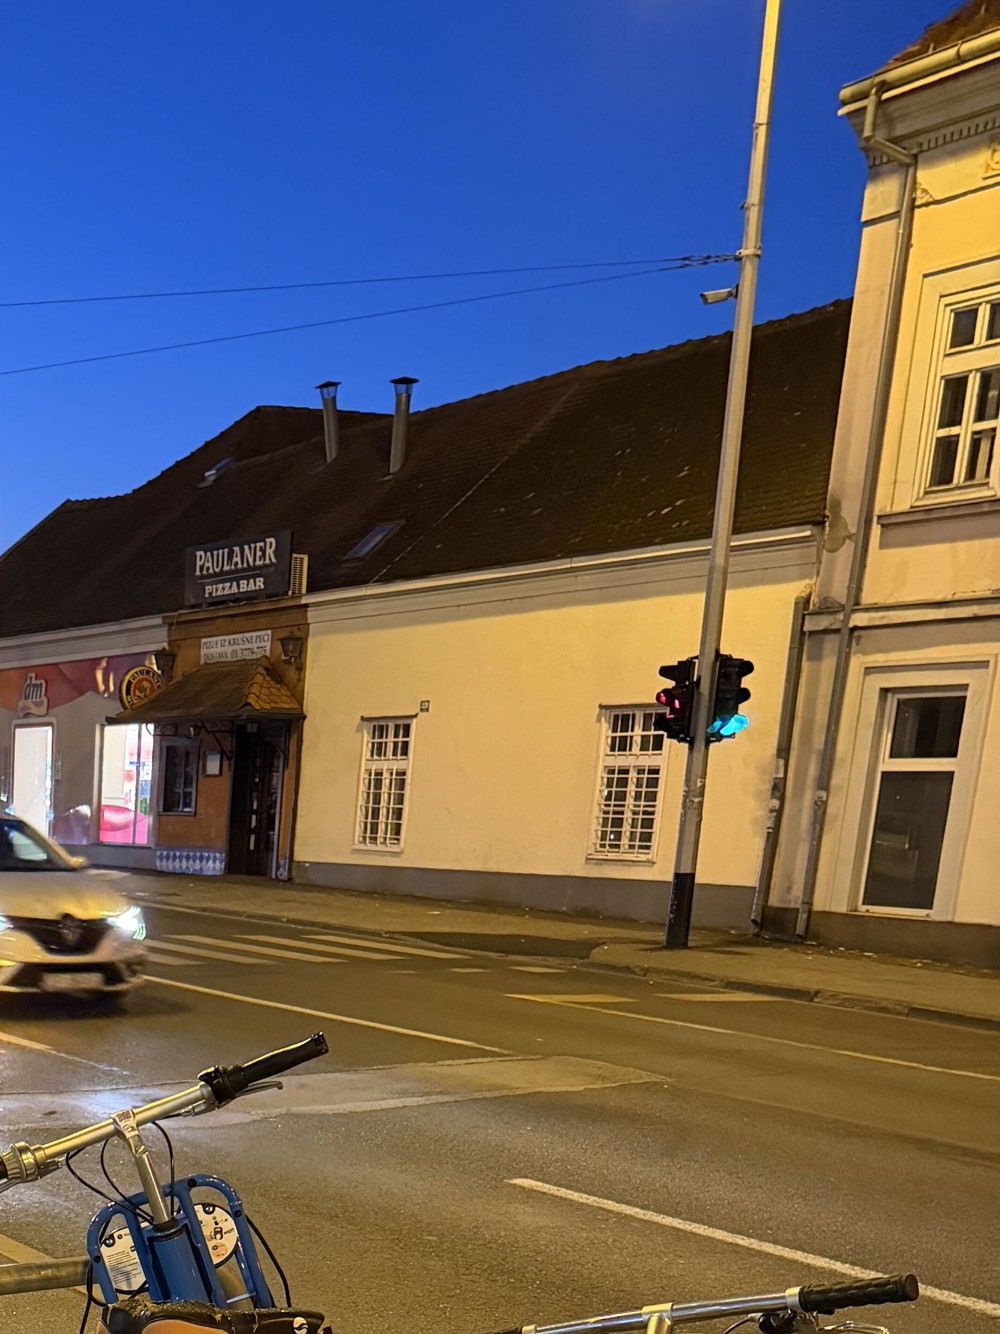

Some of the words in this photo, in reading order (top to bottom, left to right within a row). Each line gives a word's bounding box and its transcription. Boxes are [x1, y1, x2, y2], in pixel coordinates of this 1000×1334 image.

[195, 537, 277, 576] PAULANER
[204, 581, 239, 598] PIZZA
[239, 577, 265, 592] BAR
[24, 675, 43, 701] dm
